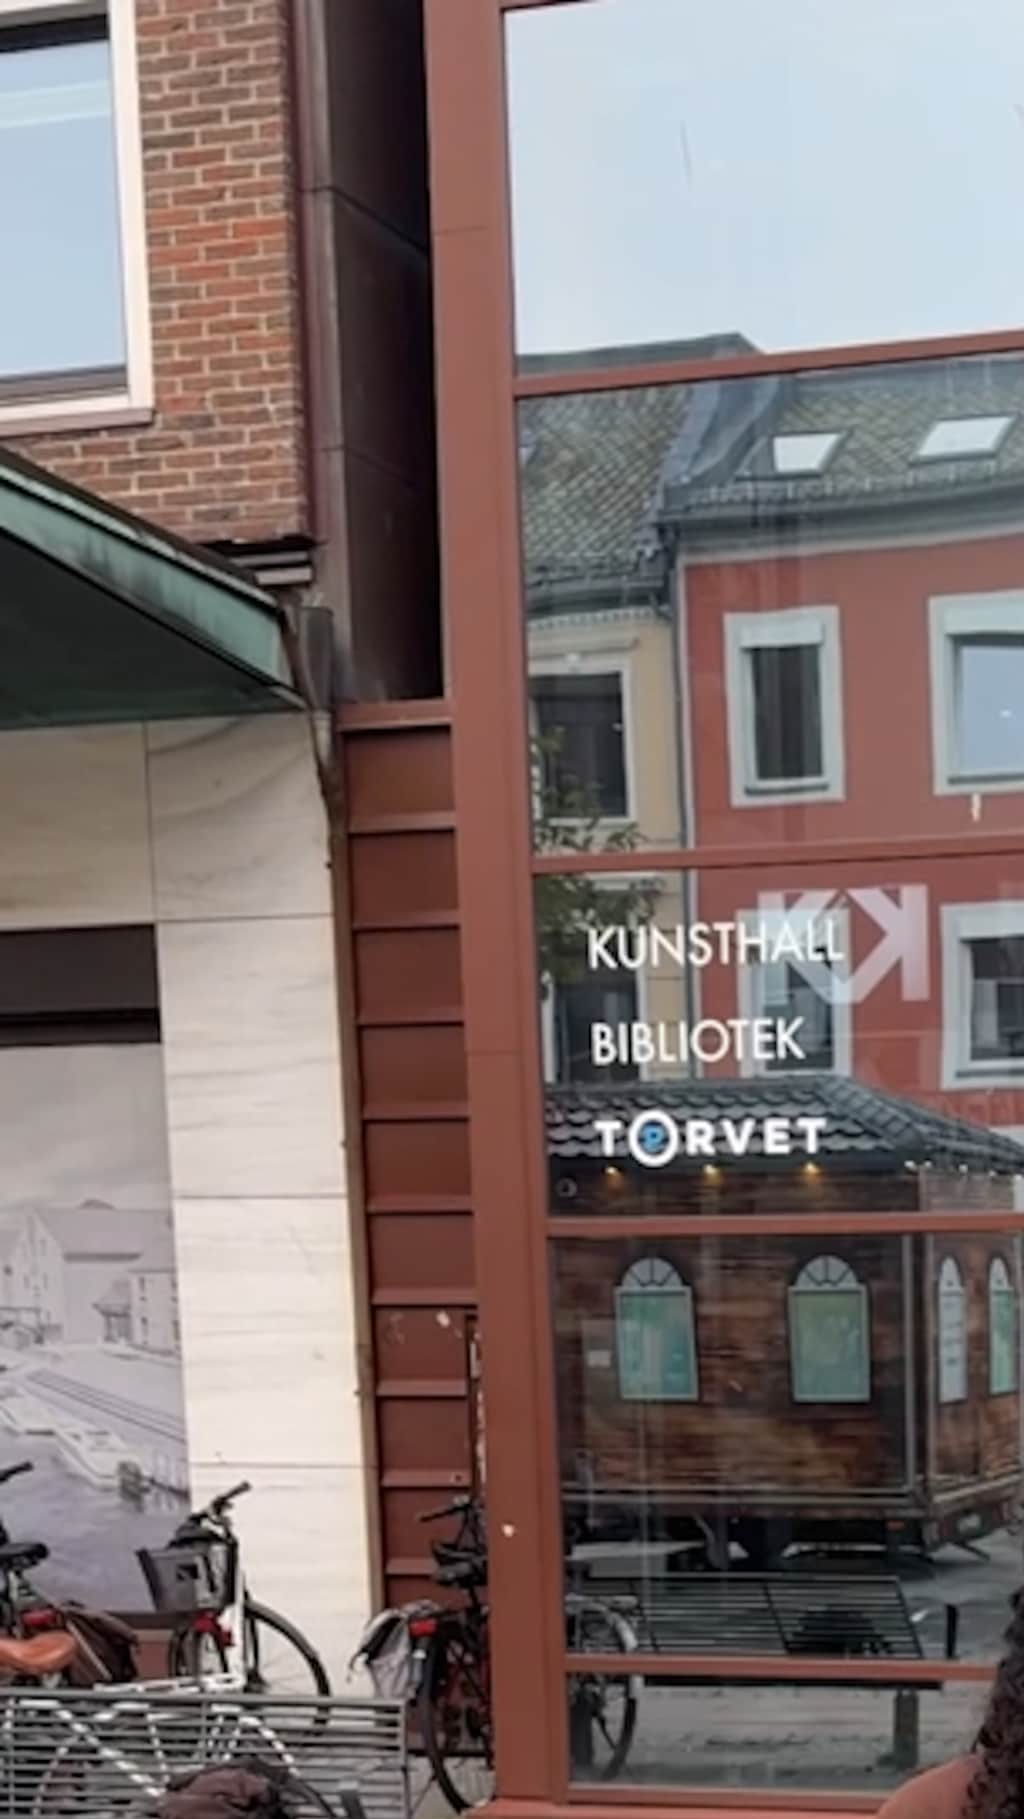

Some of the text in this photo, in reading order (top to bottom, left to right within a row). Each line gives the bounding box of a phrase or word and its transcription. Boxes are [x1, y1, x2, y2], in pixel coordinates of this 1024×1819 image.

[587, 917, 847, 969] KUNSTHALL
[589, 1015, 806, 1065] BIBLIOTEK
[594, 1110, 828, 1167] TORVET
